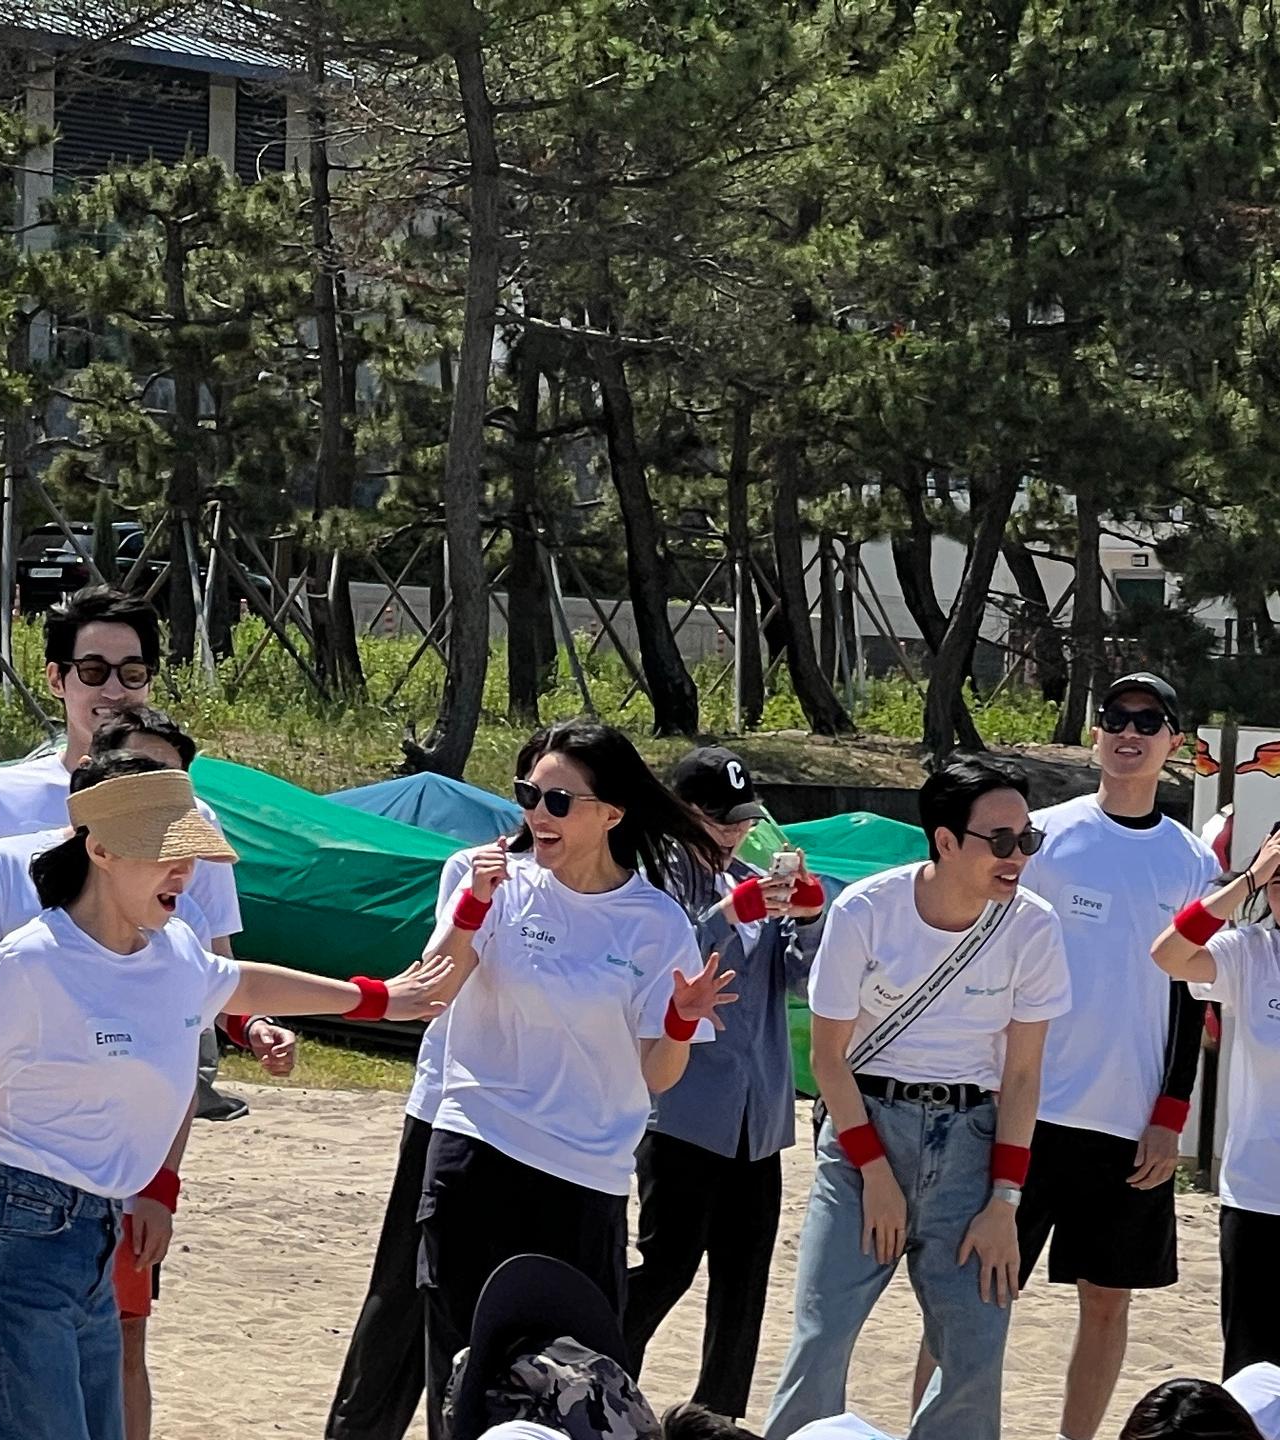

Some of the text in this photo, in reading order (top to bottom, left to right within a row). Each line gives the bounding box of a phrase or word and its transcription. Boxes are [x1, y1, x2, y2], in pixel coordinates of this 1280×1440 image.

[726, 760, 746, 789] C
[1071, 894, 1103, 911] Steve
[520, 926, 557, 945] Sadie
[95, 1031, 133, 1046] Emma
